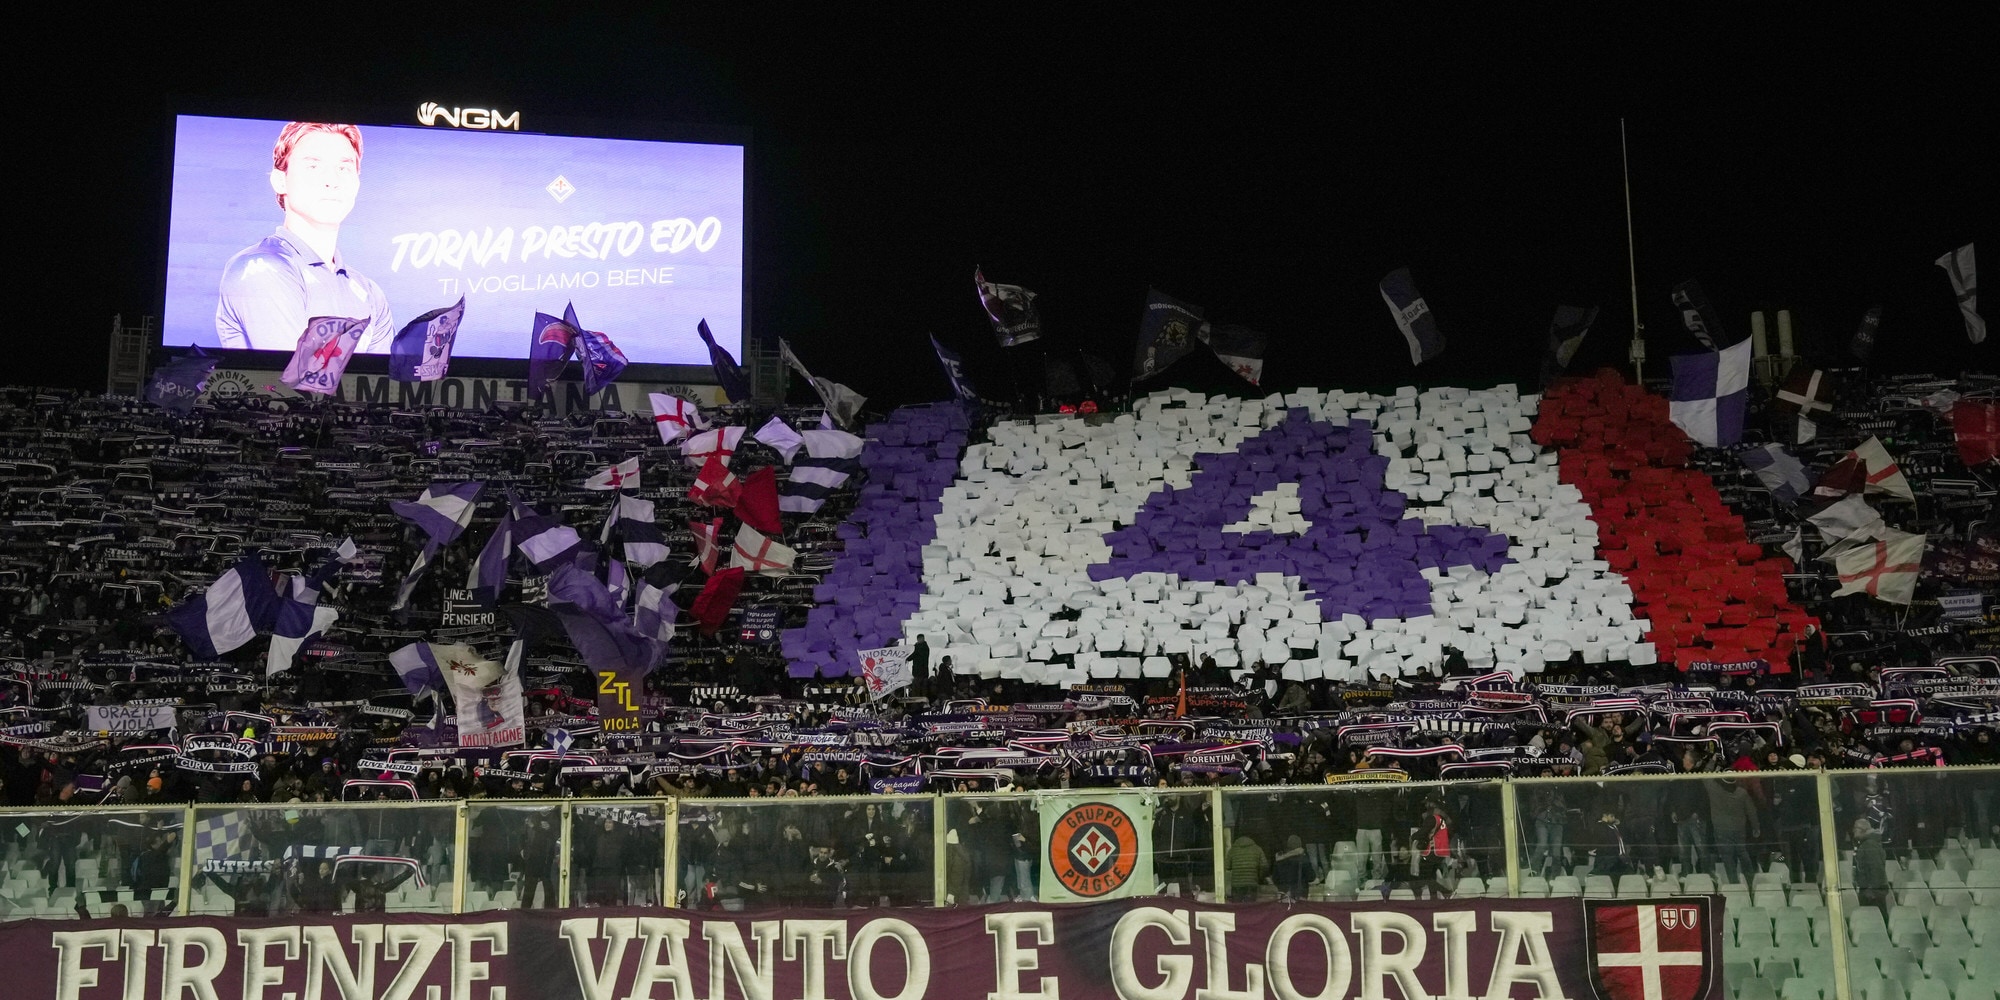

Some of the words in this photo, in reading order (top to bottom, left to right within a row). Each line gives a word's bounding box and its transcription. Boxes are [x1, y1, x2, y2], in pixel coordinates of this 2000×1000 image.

[432, 106, 520, 131] NGM
[391, 228, 510, 272] TORNA
[521, 220, 647, 262] PRESTO
[649, 215, 724, 254] EDO
[438, 277, 461, 297] TI
[465, 270, 599, 294] VOGLIAMO
[607, 265, 675, 288] BENE
[201, 371, 256, 396] SAMMONTAN
[443, 588, 474, 601] LINEA
[443, 601, 453, 613] DI
[442, 612, 495, 626] PENSIERO
[1907, 625, 1950, 637] ULTRAS
[1692, 662, 1712, 671] NOI
[1722, 660, 1758, 671] SEANO
[1538, 685, 1567, 694] CURVA
[1801, 687, 1833, 697] JUVE
[1834, 687, 1874, 698] MERDA
[1912, 684, 1988, 694] FIORENTINA
[98, 706, 159, 719] ORAZIO
[109, 718, 155, 731] VIOLA
[604, 716, 640, 732] VIOLA
[276, 732, 338, 743] AFICIONADOS
[461, 727, 523, 747] MONTAIONE
[130, 753, 187, 766] FIORENTINA
[804, 752, 868, 762] AFICIONADOS
[181, 759, 214, 771] CURVA
[229, 762, 258, 773] FIESO
[359, 759, 385, 769] JUVE
[385, 763, 418, 773] MERDA
[1066, 808, 1123, 829] GRUPPO
[1062, 866, 1126, 892] PIAGGE
[52, 921, 508, 1000] FIRENZE
[559, 915, 931, 1000] VANTO
[984, 911, 1060, 1000] E
[1109, 906, 1573, 1000] GLORIA
